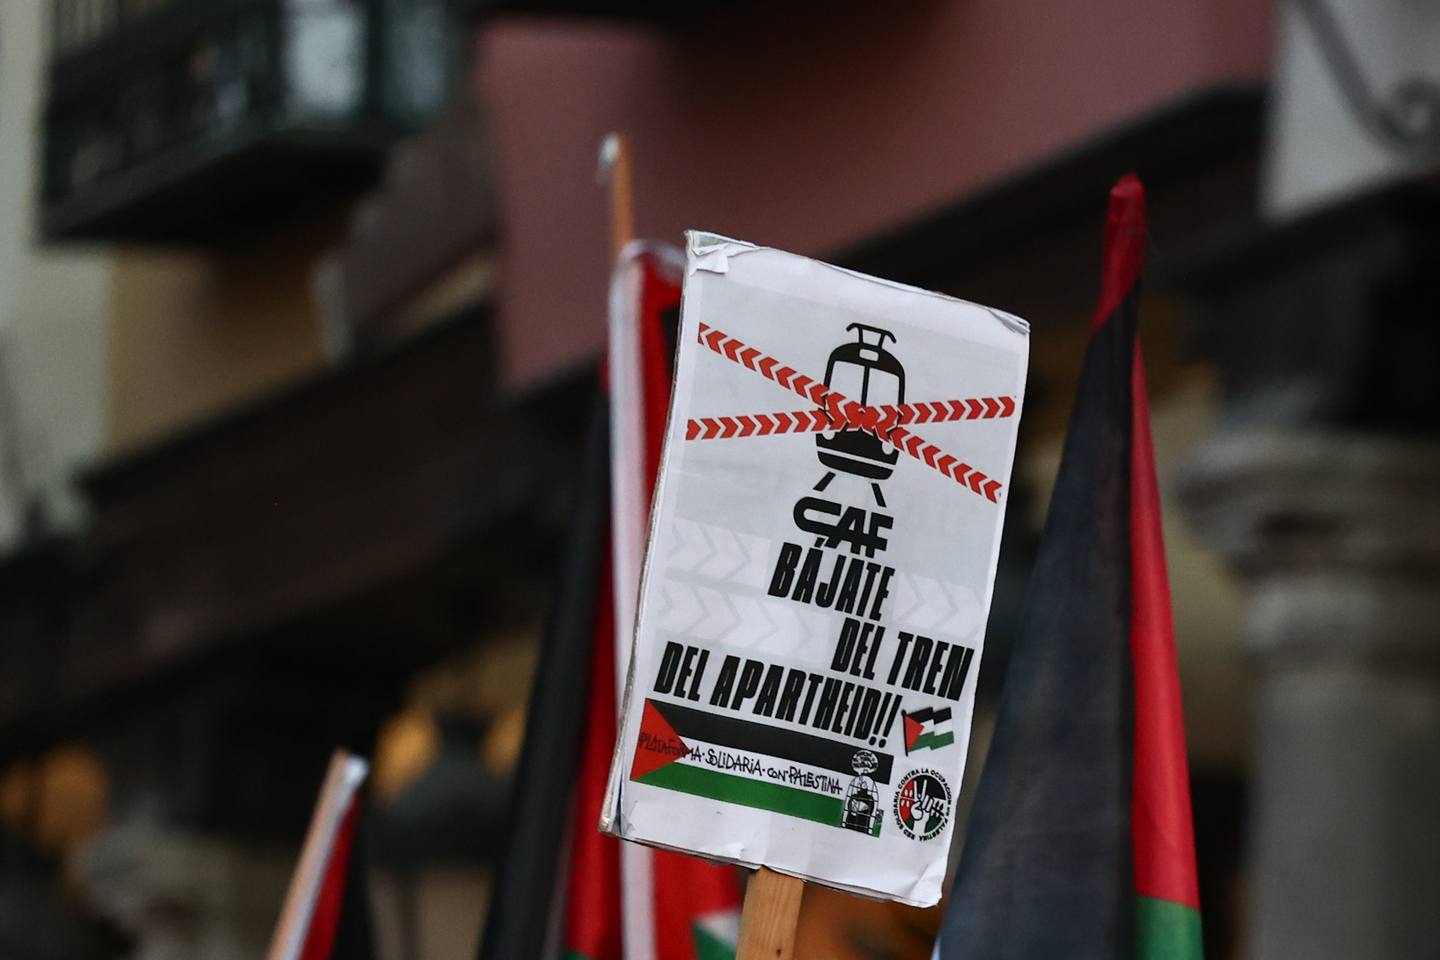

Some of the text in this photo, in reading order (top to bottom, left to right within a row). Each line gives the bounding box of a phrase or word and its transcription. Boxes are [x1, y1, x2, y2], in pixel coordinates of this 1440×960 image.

[793, 496, 894, 558] CAF
[767, 537, 895, 622] BÁJATE
[652, 641, 904, 748] DEL APARTHEID!!
[829, 617, 975, 702] DEL TREN
